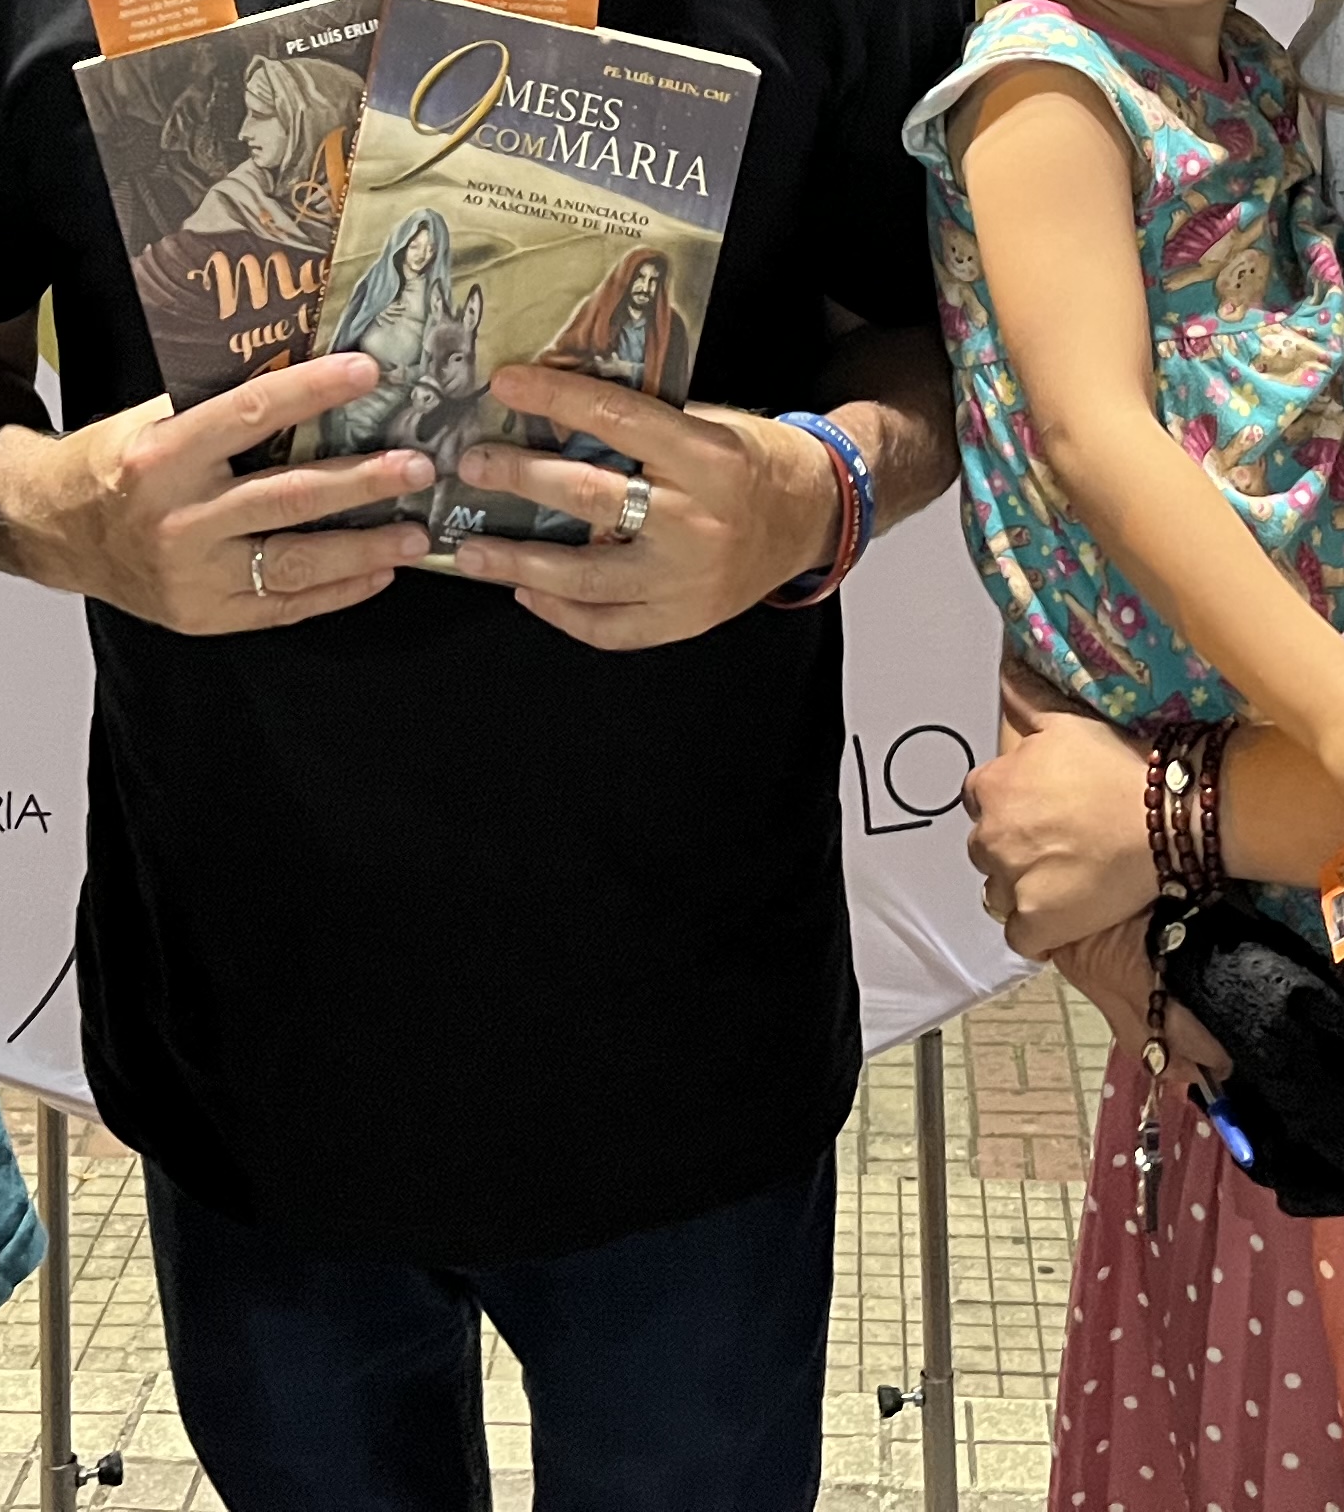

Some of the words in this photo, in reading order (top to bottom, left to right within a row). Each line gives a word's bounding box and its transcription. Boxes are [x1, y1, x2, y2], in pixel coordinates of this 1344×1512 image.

[310, 26, 343, 48] LUÍS
[368, 40, 510, 191] 9
[496, 74, 623, 131] MESES
[474, 123, 547, 159] COM
[547, 125, 709, 196] MARIA
[463, 194, 483, 206] AO
[488, 197, 578, 224] NASCIMENTO
[582, 218, 600, 230] DE
[604, 222, 642, 239] JESUS
[467, 179, 523, 199] NOVENA
[529, 192, 547, 204] DA
[554, 198, 649, 226] ANUNCIAÇÃO
[229, 318, 296, 362] que
